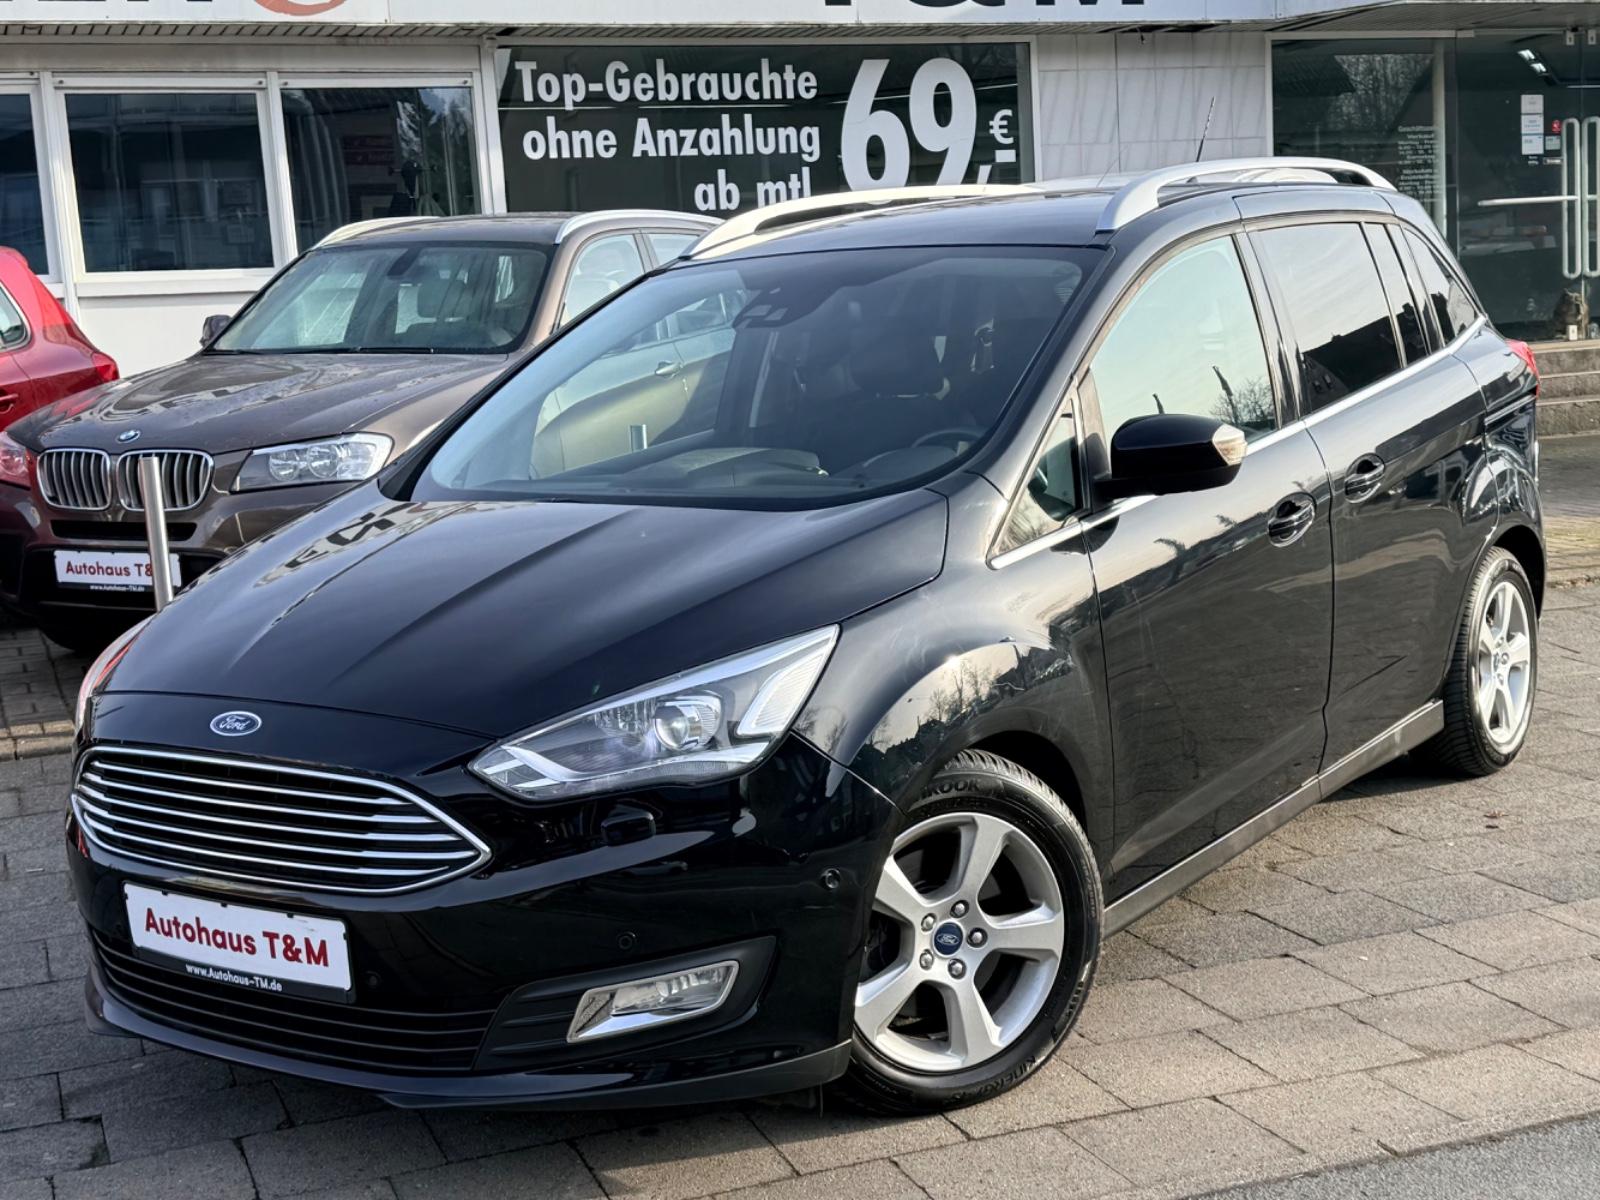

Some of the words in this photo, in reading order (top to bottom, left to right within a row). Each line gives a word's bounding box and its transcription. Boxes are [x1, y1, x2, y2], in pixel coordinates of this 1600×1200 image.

[516, 60, 817, 111] Top-Gebrauchte
[522, 117, 617, 160] ohne
[633, 113, 821, 163] Anzahlung
[694, 169, 740, 211] ab
[65, 560, 131, 577] Autohaus
[144, 908, 257, 956] Autohaus
[262, 931, 329, 967] T&M
[185, 963, 284, 993] www.Autohaus-TM.de
